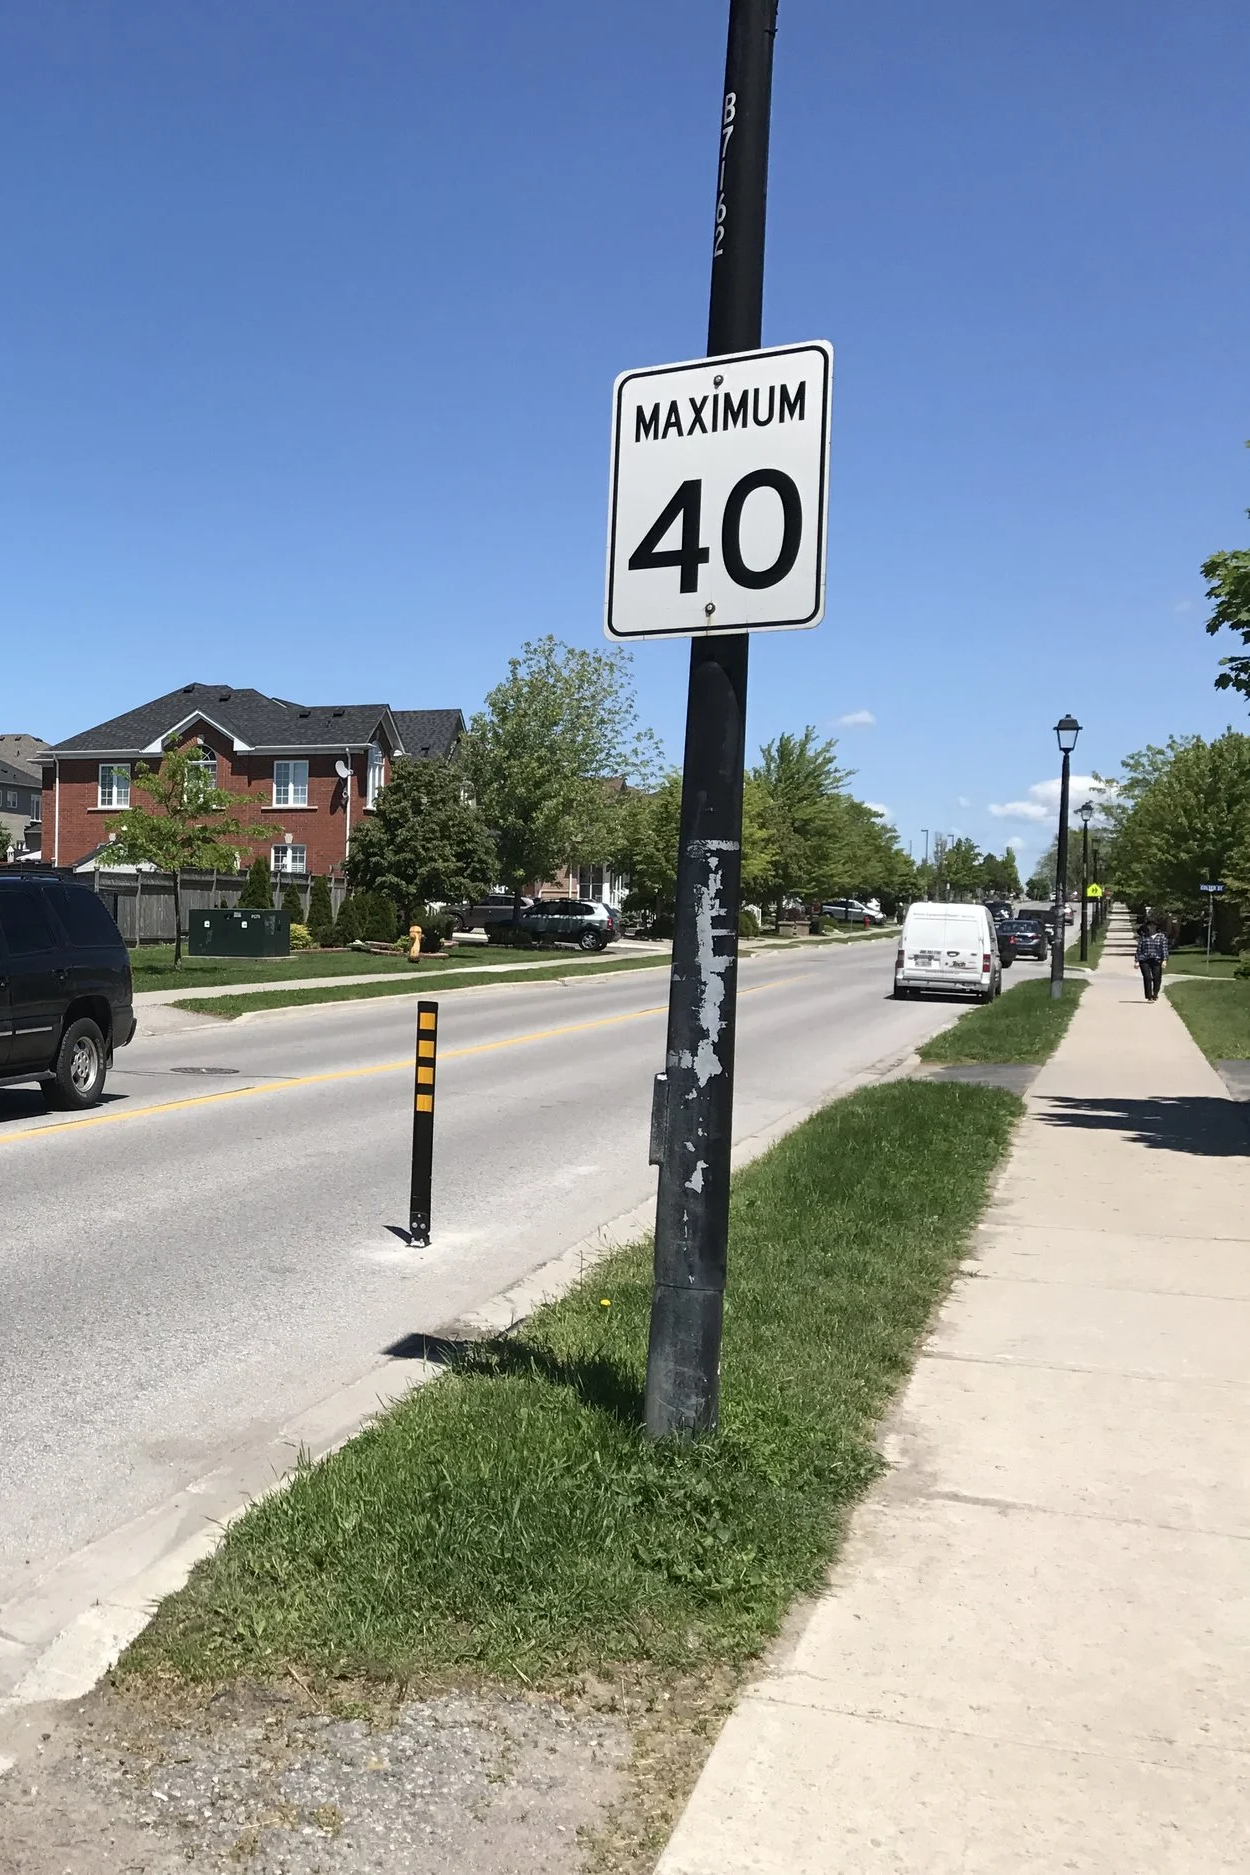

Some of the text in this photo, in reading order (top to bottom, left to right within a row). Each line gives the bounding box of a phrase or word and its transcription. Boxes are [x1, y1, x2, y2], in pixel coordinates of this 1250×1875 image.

[713, 92, 737, 257] B7162
[634, 380, 807, 443] MAXIMUM
[628, 468, 803, 594] 40
